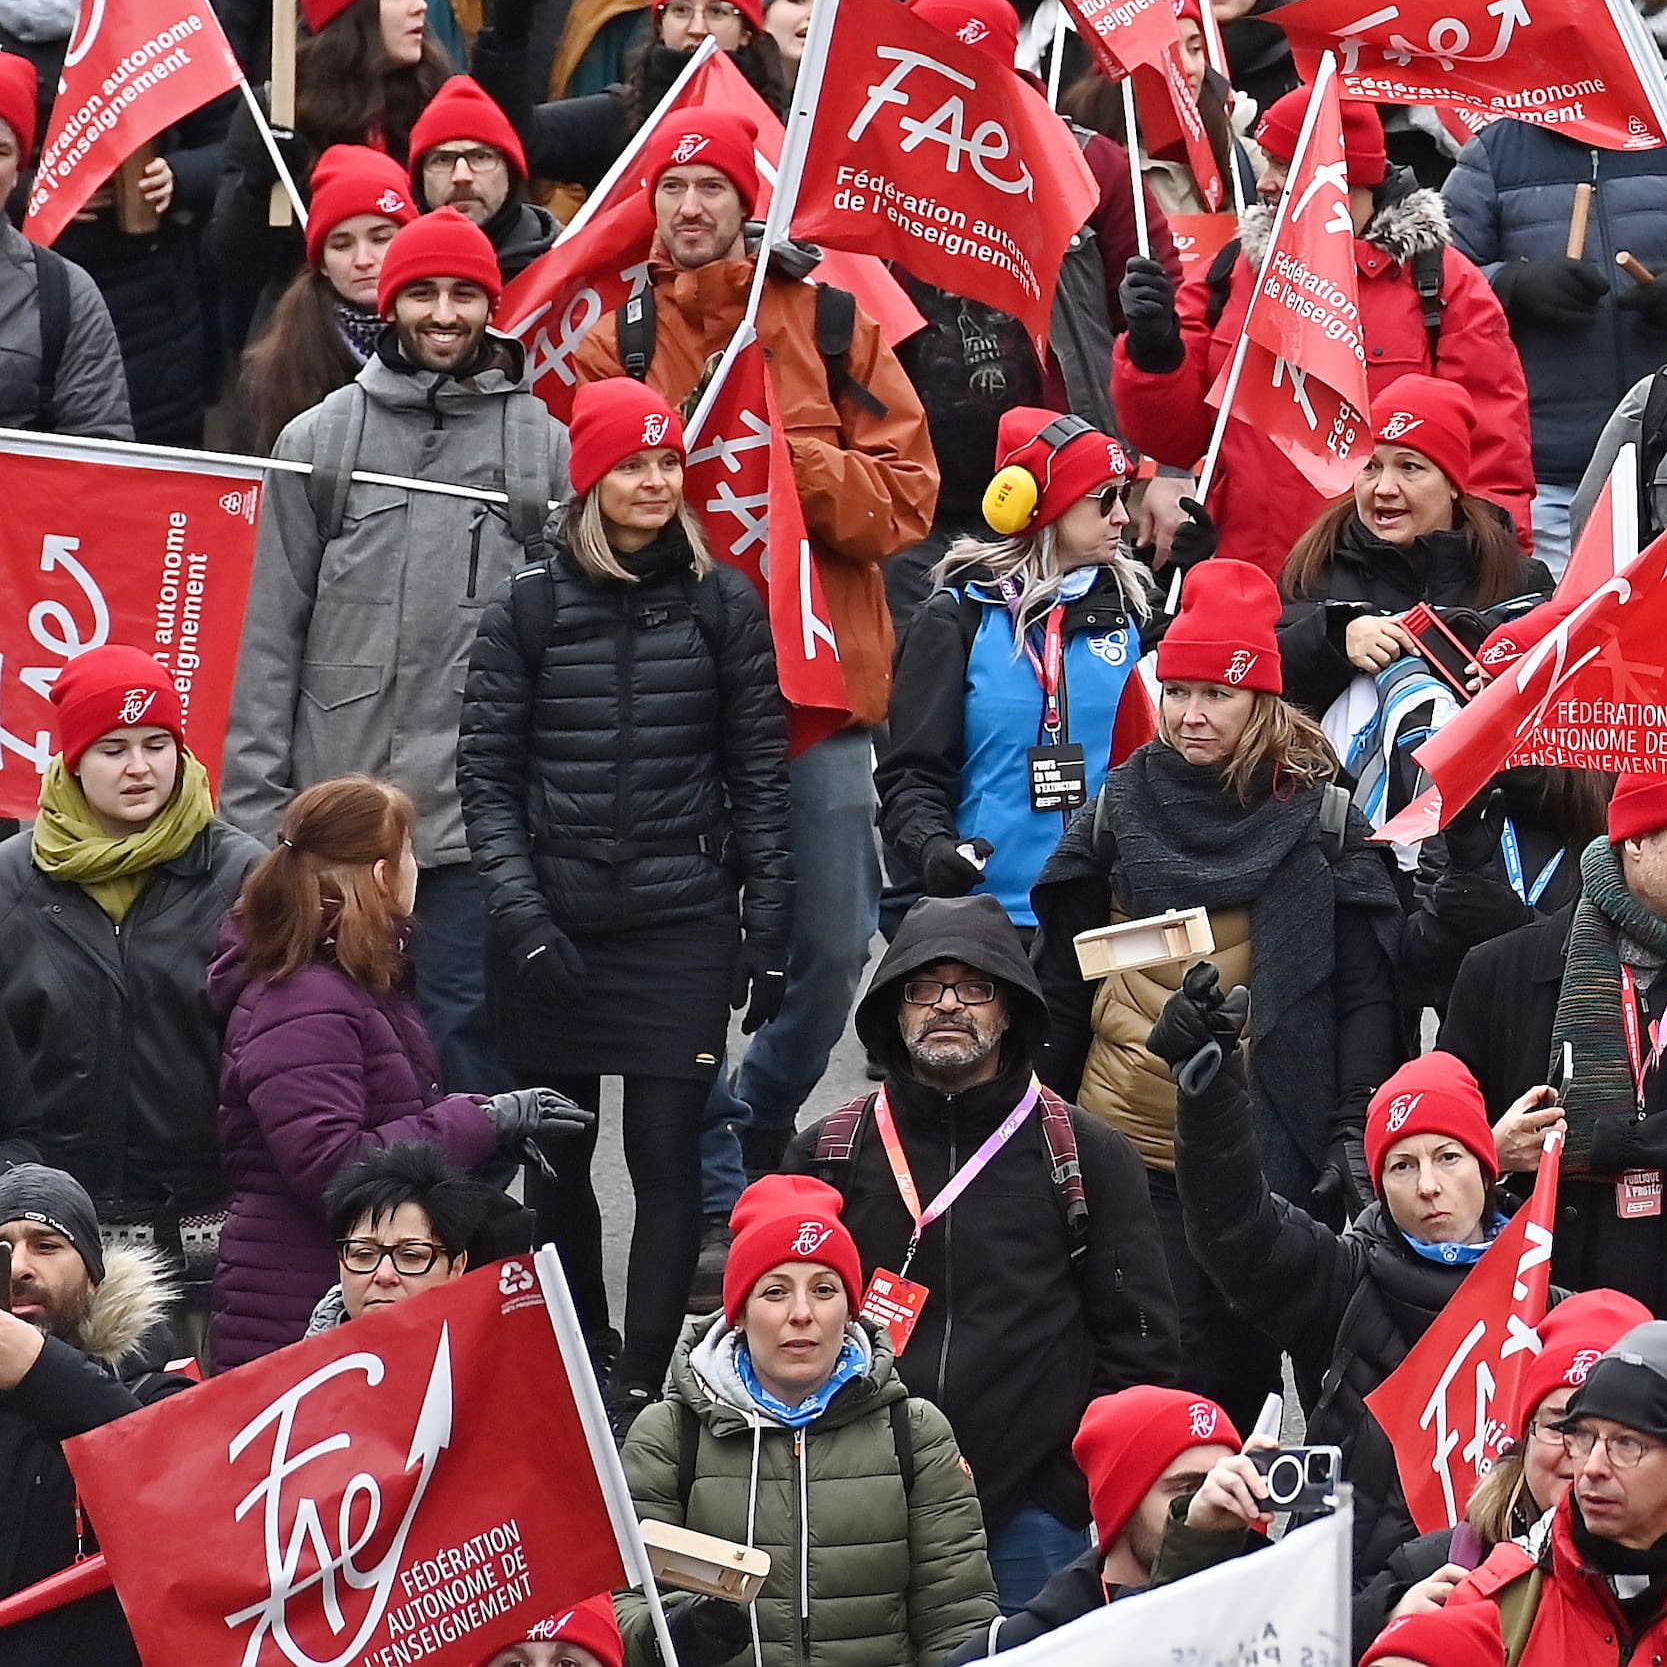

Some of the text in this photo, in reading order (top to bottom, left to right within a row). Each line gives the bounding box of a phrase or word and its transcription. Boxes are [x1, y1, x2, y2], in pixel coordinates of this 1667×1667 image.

[101, 13, 202, 93] autonome
[44, 48, 192, 190] l'enseignement
[833, 189, 1032, 297] de l'enseignement
[836, 165, 1041, 301] Fédération autonome
[1263, 275, 1281, 296] de
[1271, 250, 1359, 321] Fédération
[155, 510, 188, 645] autonome
[1531, 726, 1637, 755] AUTONOME
[387, 1546, 529, 1640] AUTONOME DE
[400, 1519, 521, 1597] FÉDÉRATION
[363, 1571, 533, 1667] L'ENSEIGNEMENT
